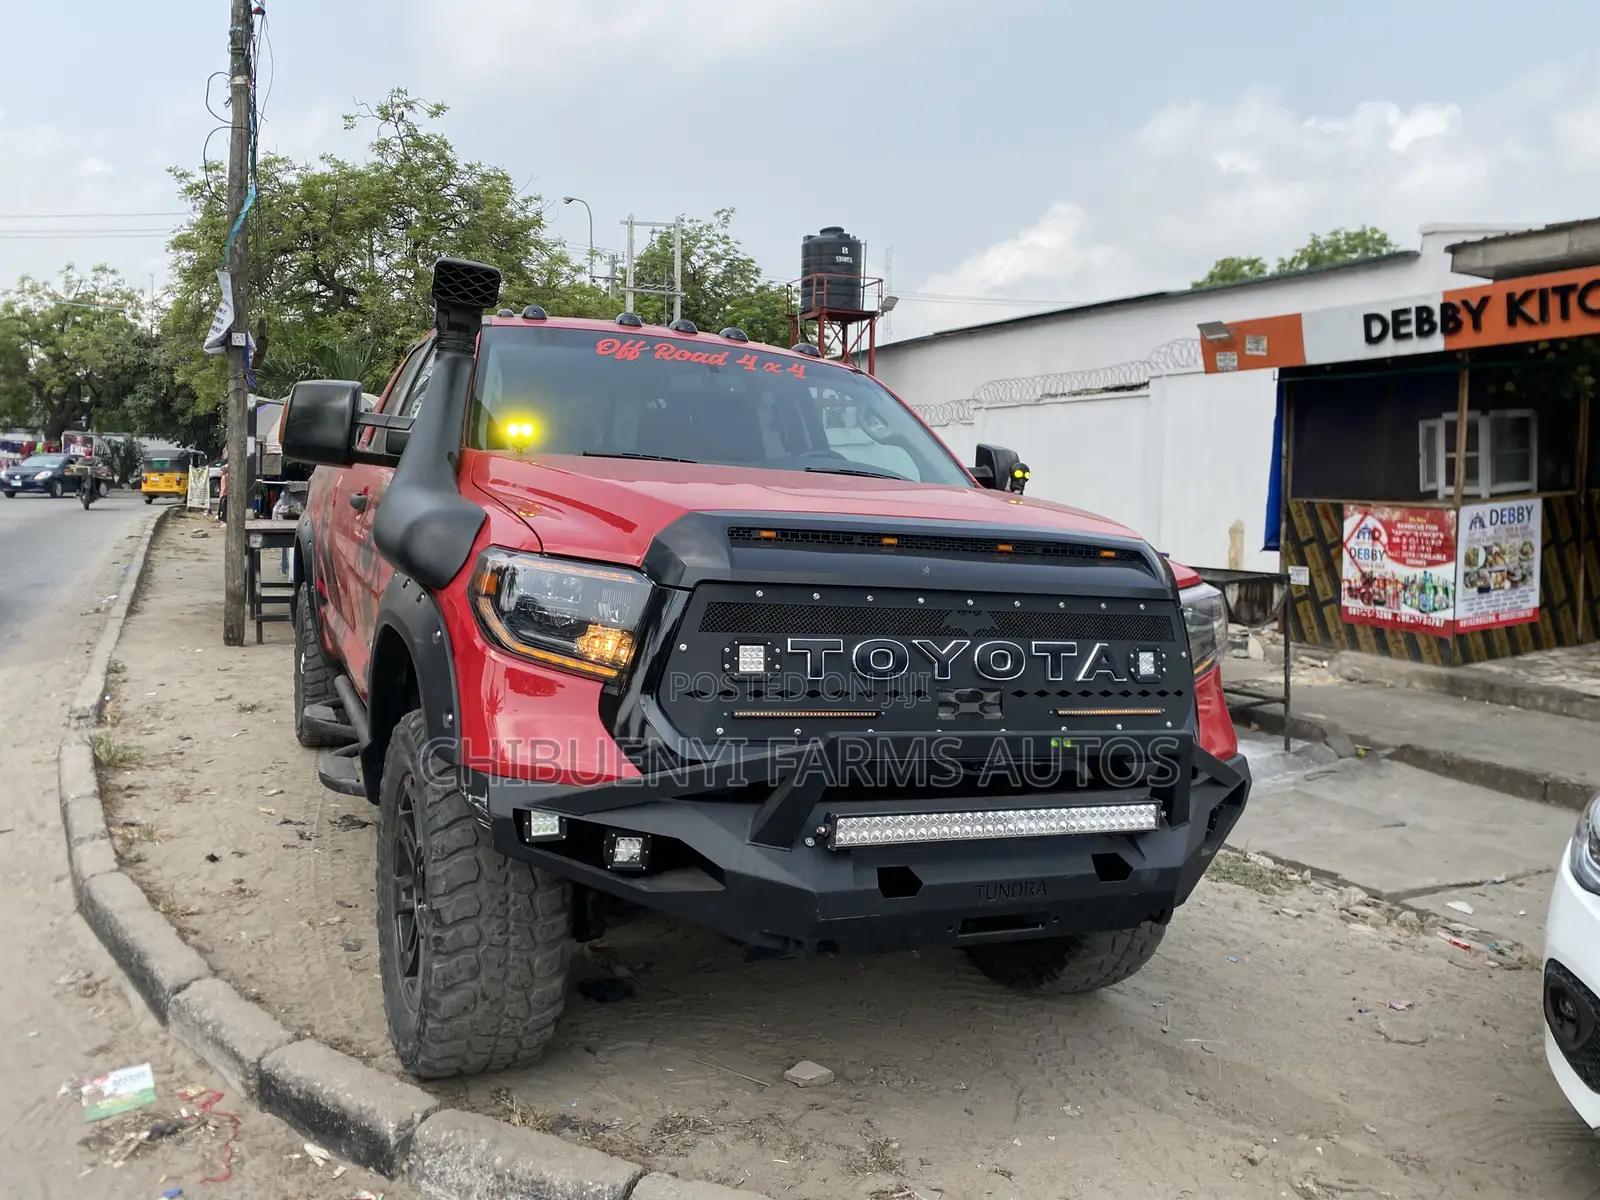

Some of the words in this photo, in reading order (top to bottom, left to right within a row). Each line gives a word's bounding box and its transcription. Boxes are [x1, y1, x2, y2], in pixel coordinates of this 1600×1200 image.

[1362, 295, 1491, 345] DEBBY
[595, 337, 650, 361] Off
[654, 342, 730, 366] Road
[735, 354, 758, 371] 4
[786, 363, 807, 379] 4
[1489, 504, 1534, 526] DEBBY
[1349, 547, 1386, 562] DEBBY
[787, 637, 1127, 682] TOYOTA
[974, 880, 1047, 901] TUNDRA
